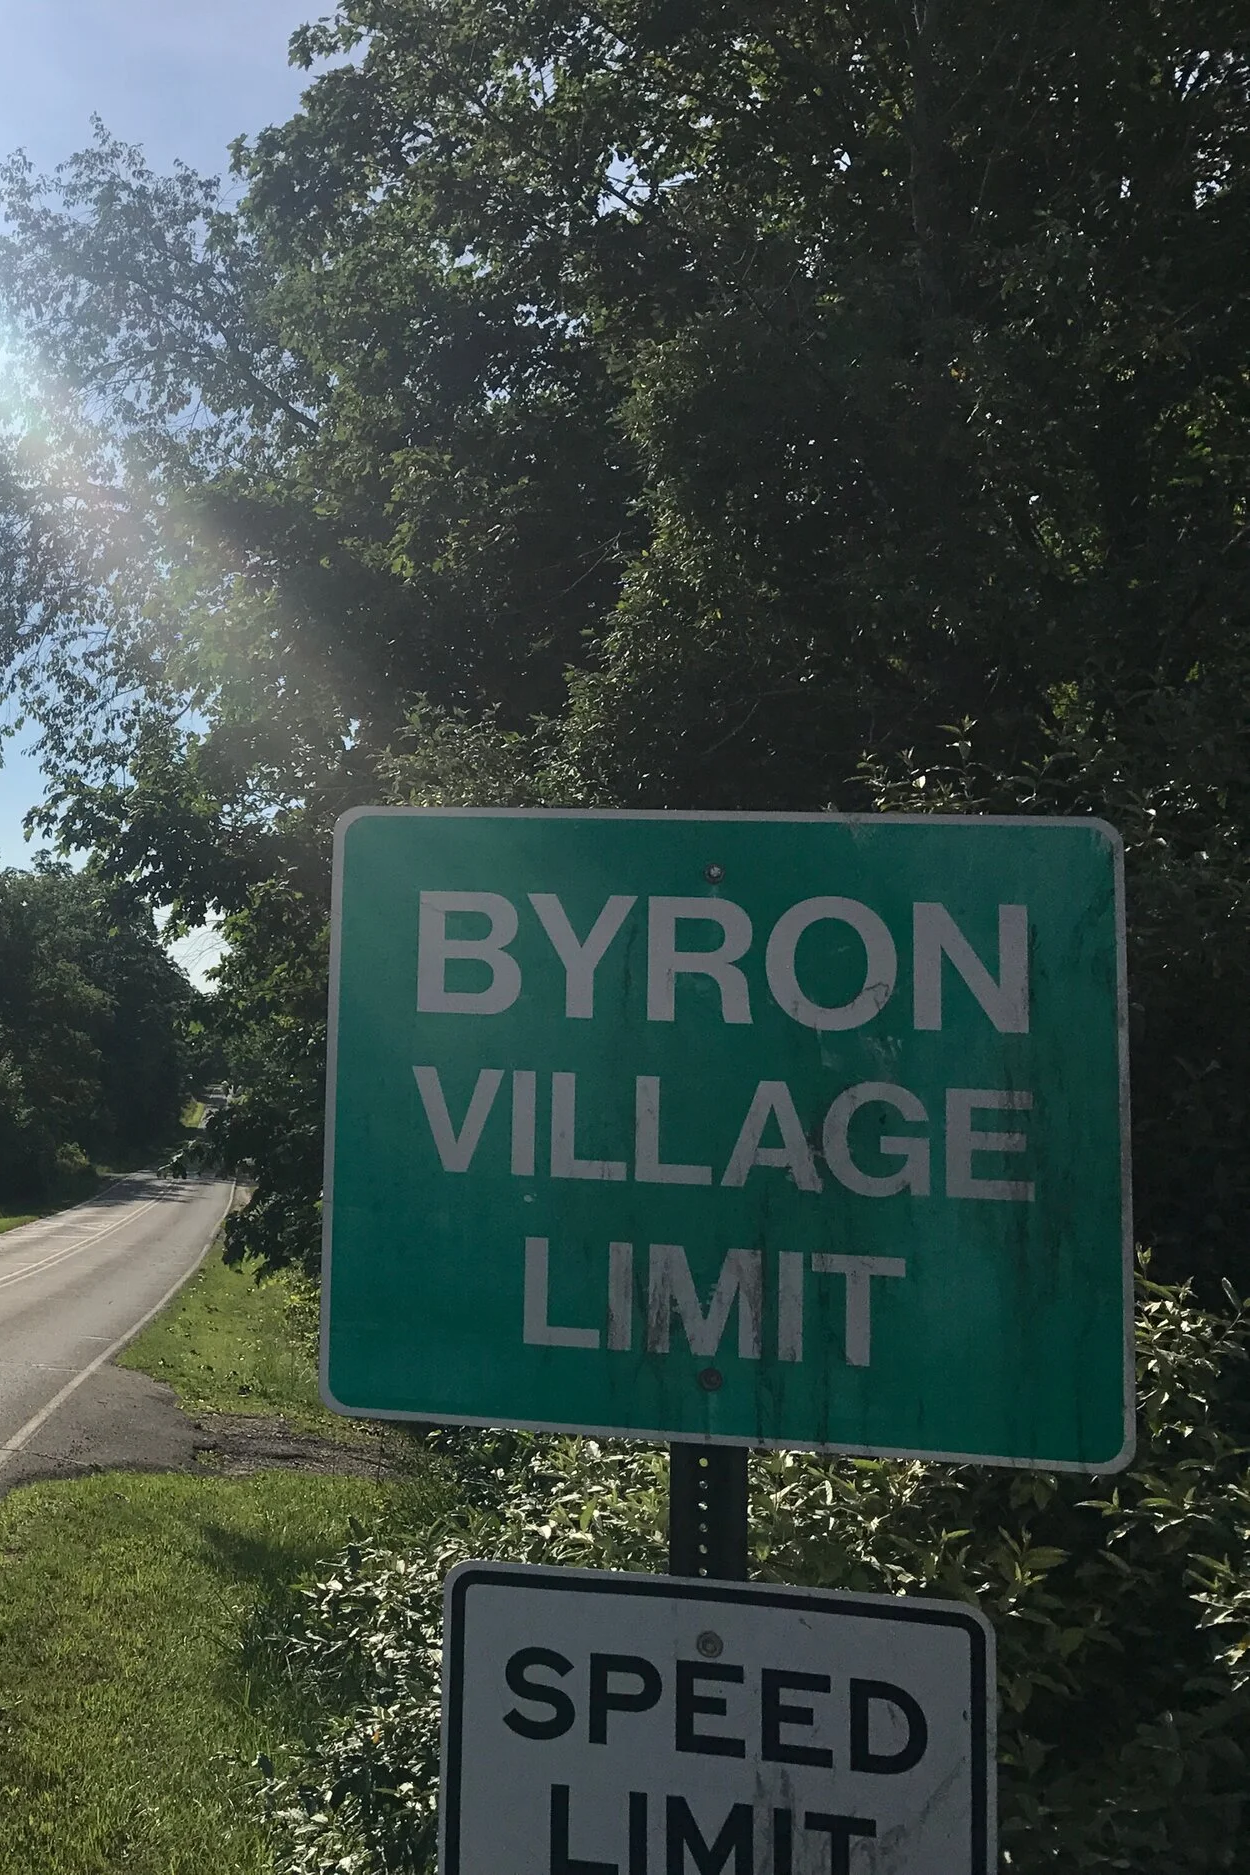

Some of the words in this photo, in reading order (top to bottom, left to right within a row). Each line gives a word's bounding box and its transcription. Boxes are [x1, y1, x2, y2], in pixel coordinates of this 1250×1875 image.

[416, 890, 1031, 1034] BYRON
[412, 1066, 1036, 1202] VILLAGE
[523, 1237, 906, 1367] LIMIT
[502, 1646, 928, 1775] SPEED
[549, 1783, 877, 1875] LIMIT
